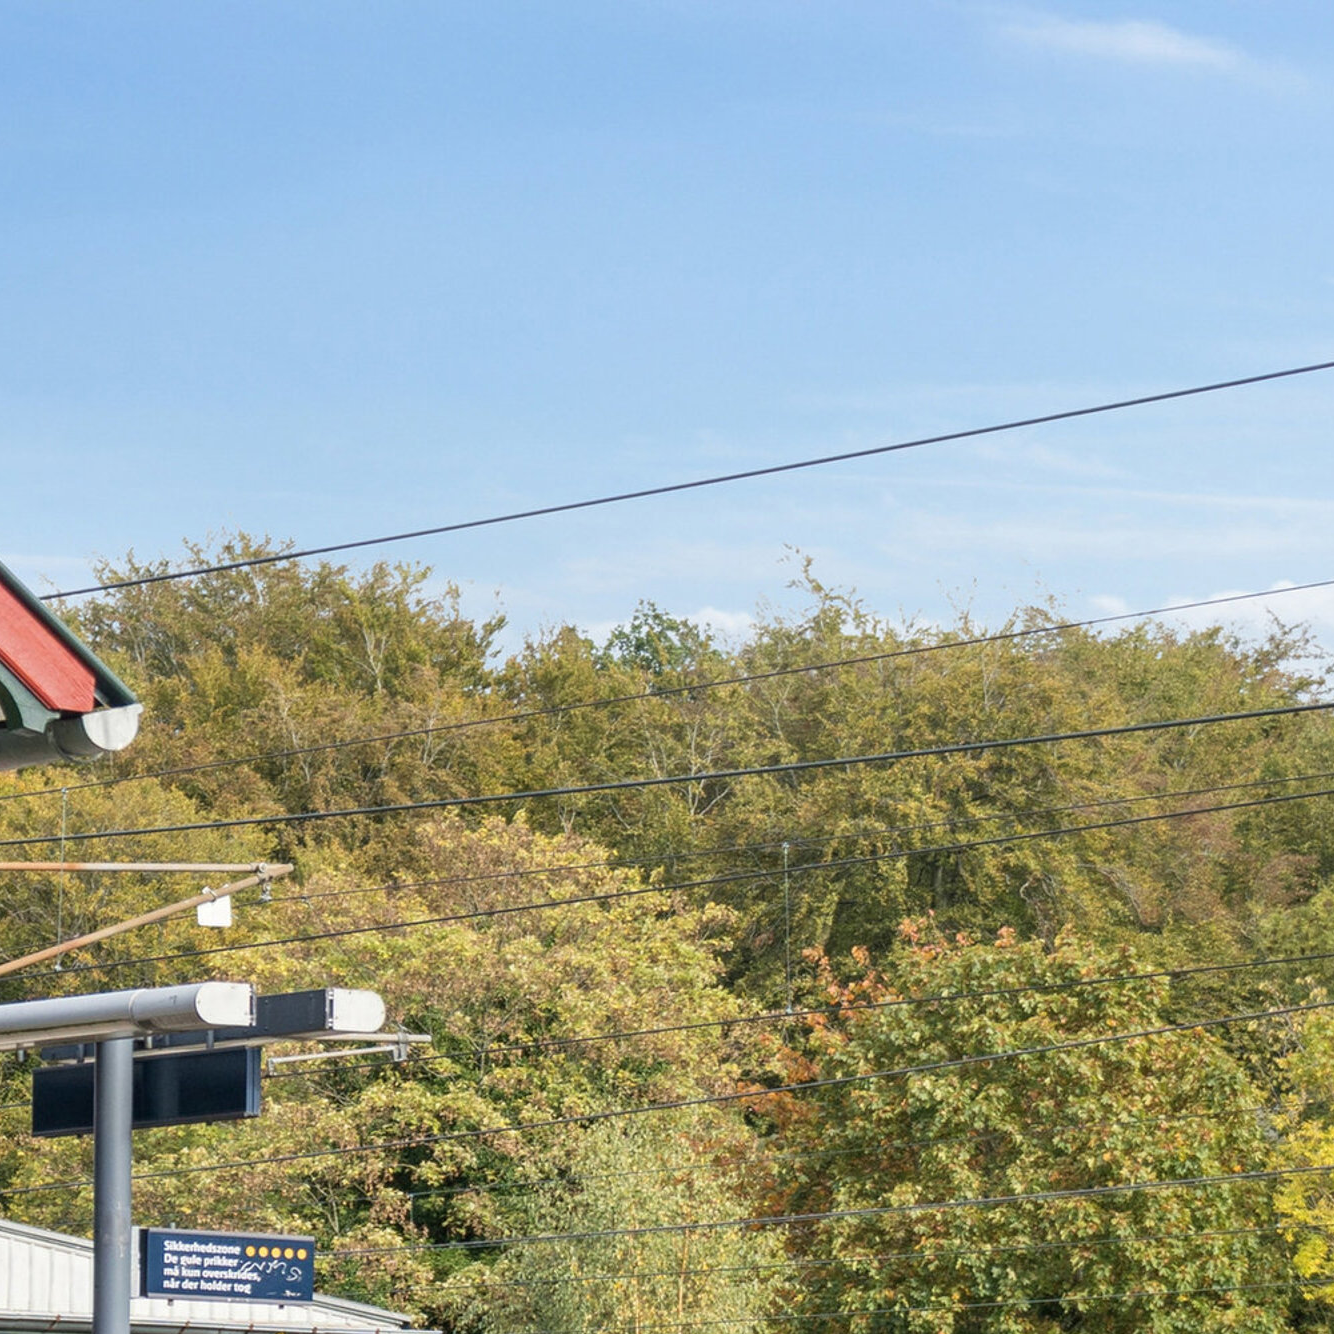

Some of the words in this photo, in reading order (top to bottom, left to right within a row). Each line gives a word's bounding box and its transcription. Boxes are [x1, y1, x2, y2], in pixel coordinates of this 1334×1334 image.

[163, 1240, 242, 1255] Sikkerhedszone
[164, 1252, 178, 1264] De
[180, 1254, 202, 1266] gule
[204, 1255, 239, 1267] prikker
[163, 1266, 179, 1276] må
[181, 1266, 201, 1276] kun
[202, 1268, 261, 1282] overskrides,
[163, 1277, 180, 1289] når
[181, 1278, 199, 1290] der
[200, 1280, 232, 1292] holder
[233, 1283, 252, 1294] tog
